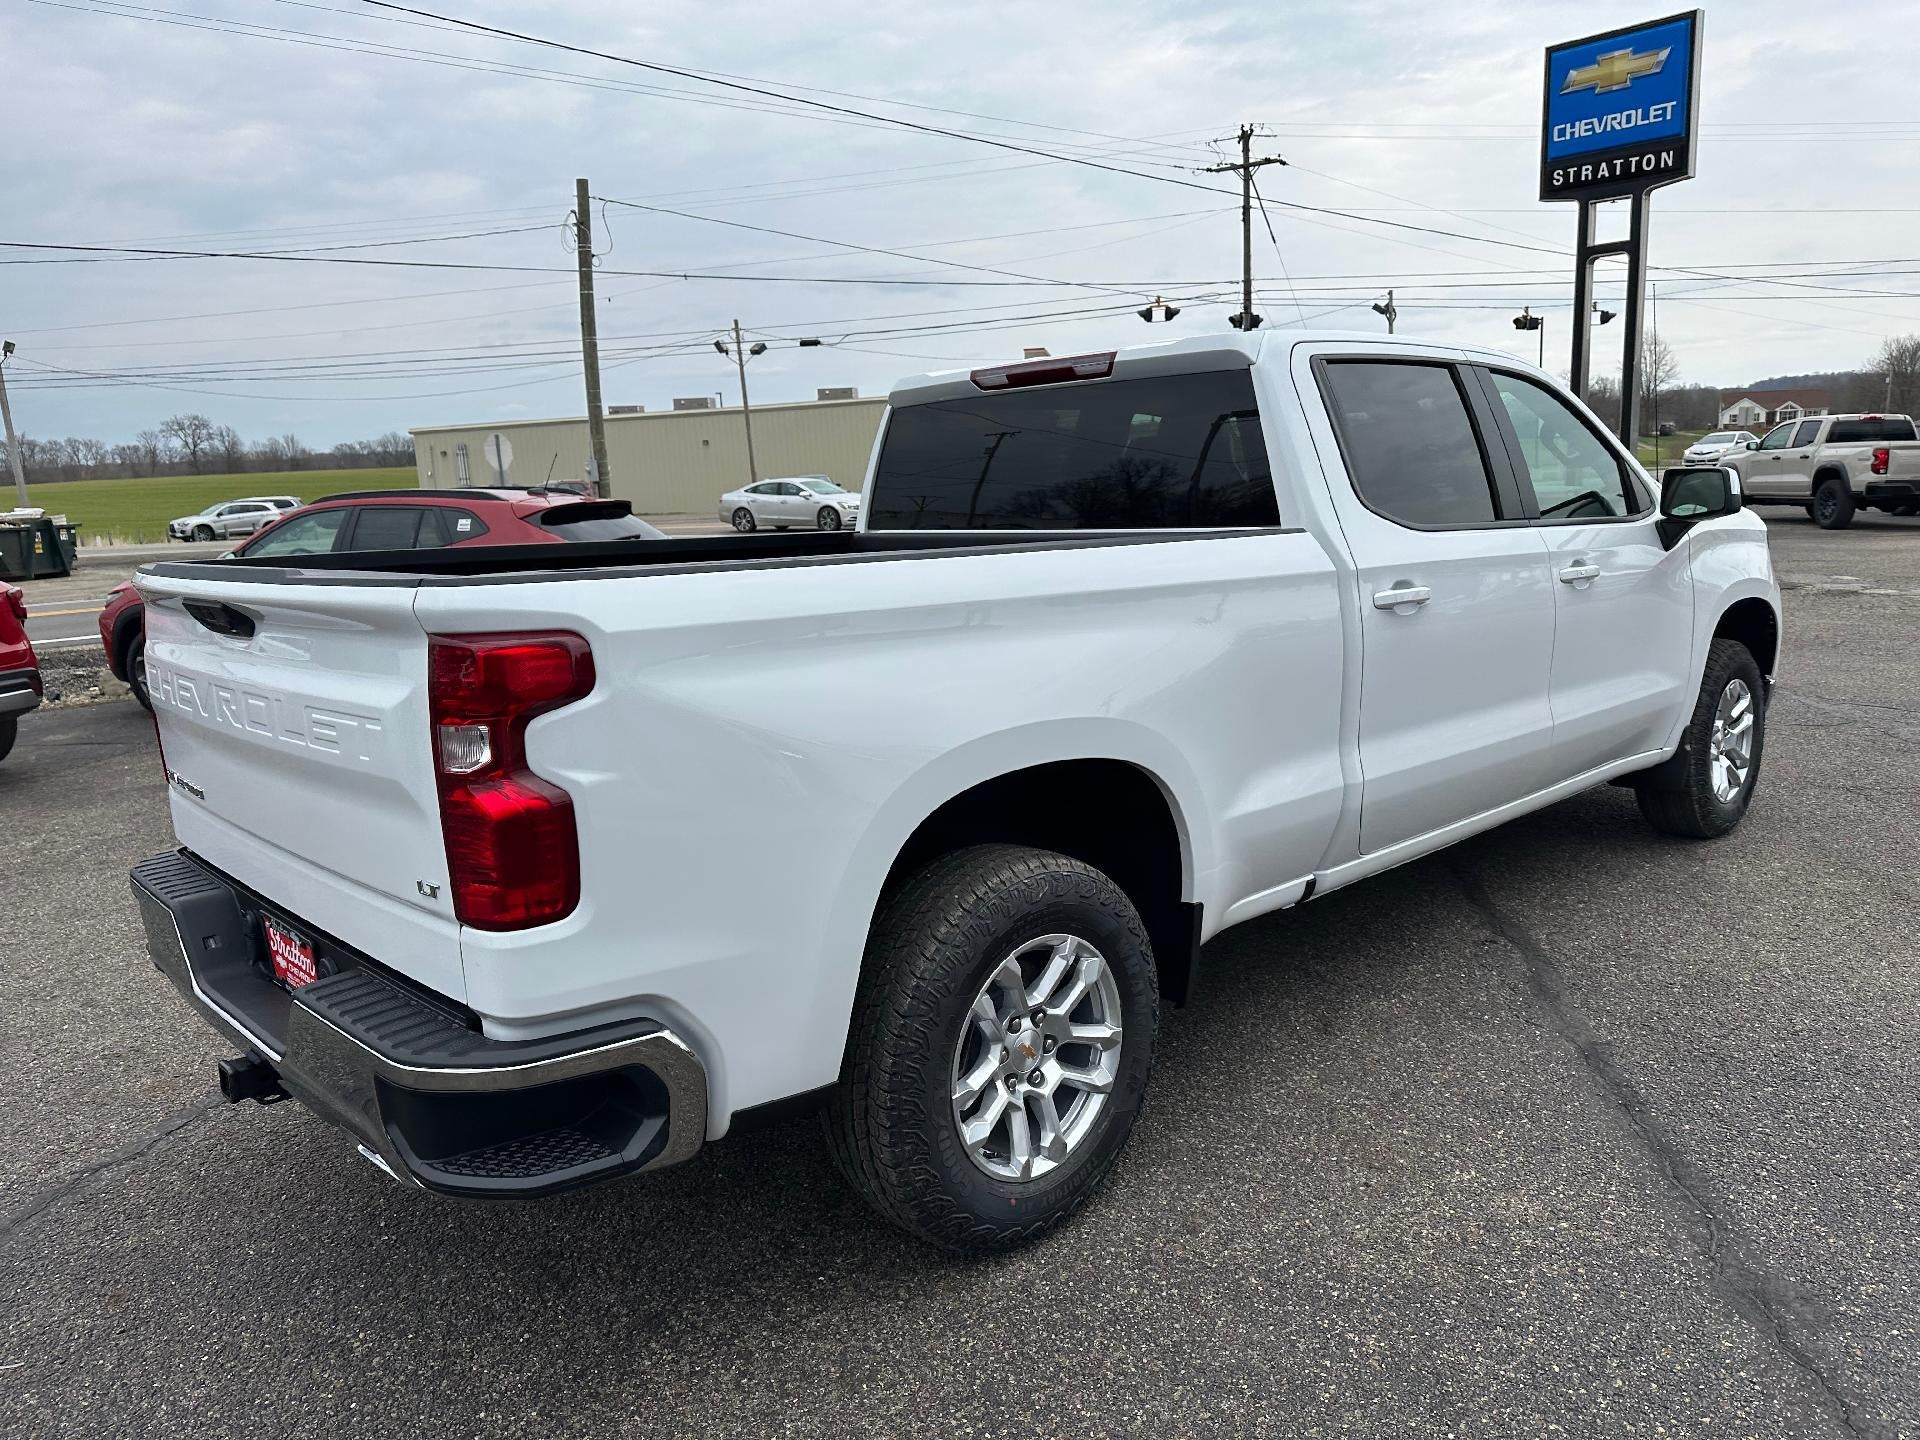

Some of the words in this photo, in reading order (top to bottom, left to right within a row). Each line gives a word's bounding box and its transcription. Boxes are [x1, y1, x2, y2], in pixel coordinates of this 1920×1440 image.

[1553, 101, 1676, 142] CHEVROLET
[1552, 151, 1674, 186] STRATTON
[146, 662, 381, 761] CHEVROLET
[416, 879, 440, 899] LT
[270, 927, 316, 977] Stratton
